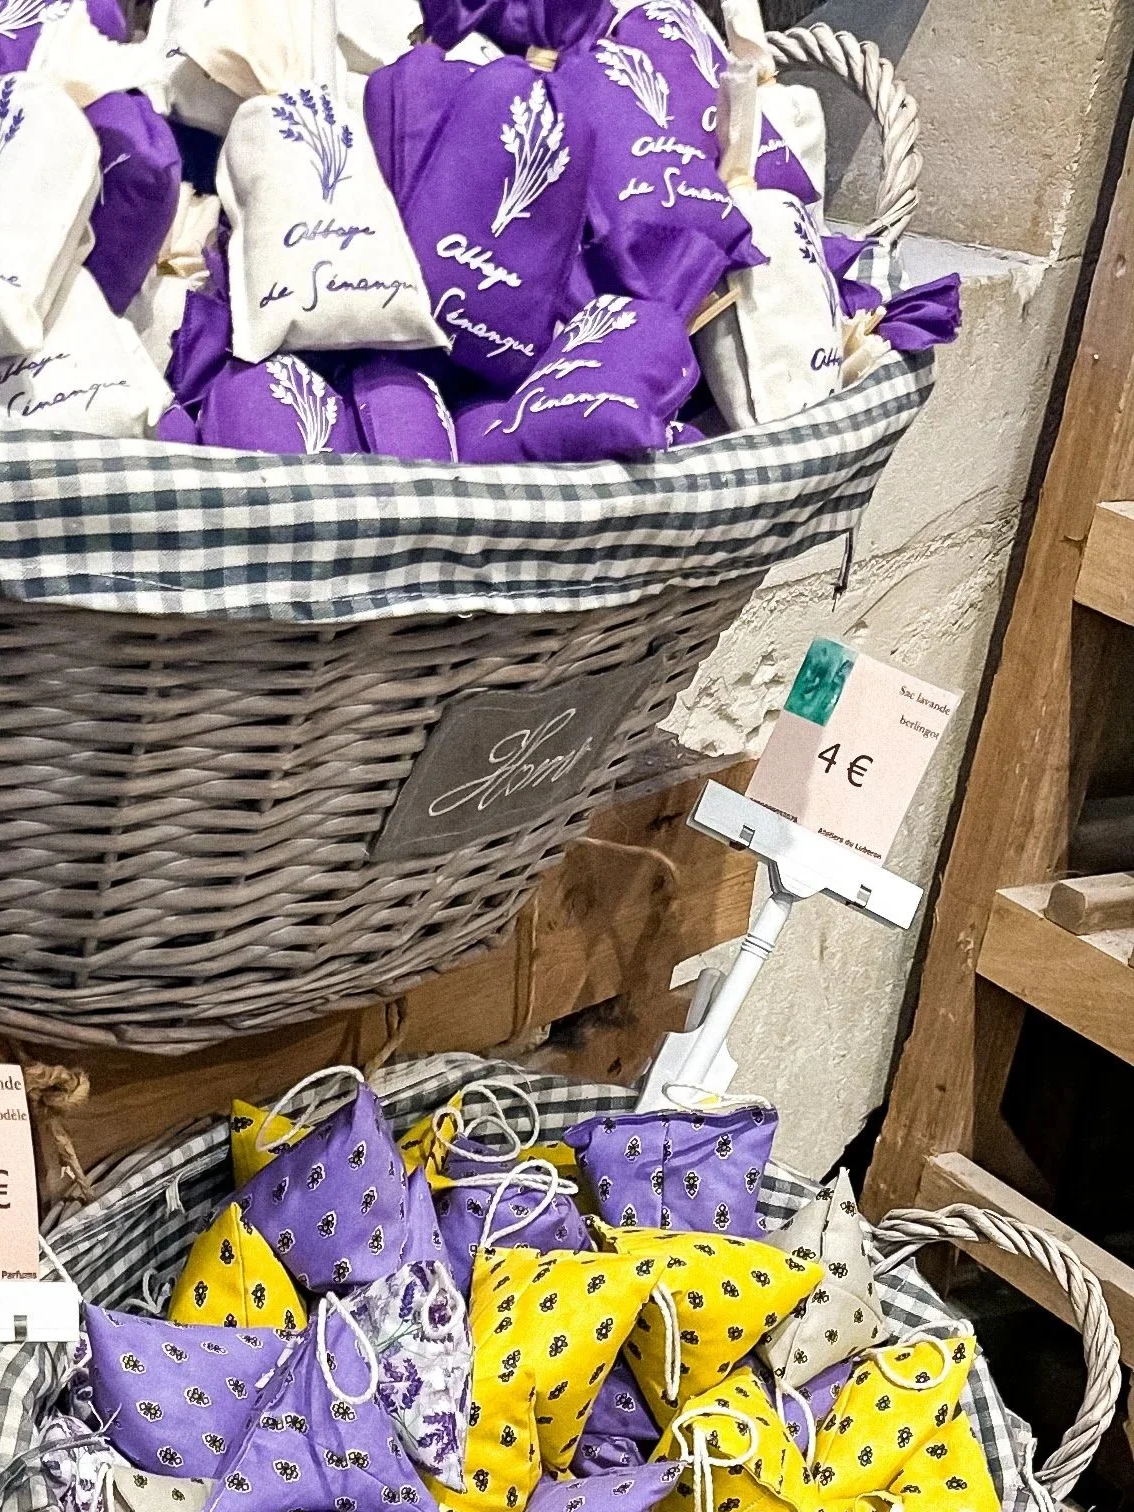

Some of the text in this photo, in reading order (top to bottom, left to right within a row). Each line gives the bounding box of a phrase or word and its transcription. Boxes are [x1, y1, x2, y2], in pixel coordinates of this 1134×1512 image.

[283, 219, 376, 250] Abbaye
[260, 282, 294, 309] de
[898, 684, 951, 716] Sac lavande
[899, 714, 940, 741] berlingot
[428, 708, 593, 816] Home
[817, 742, 874, 788] 4 €
[1, 1270, 38, 1280] Parfums
